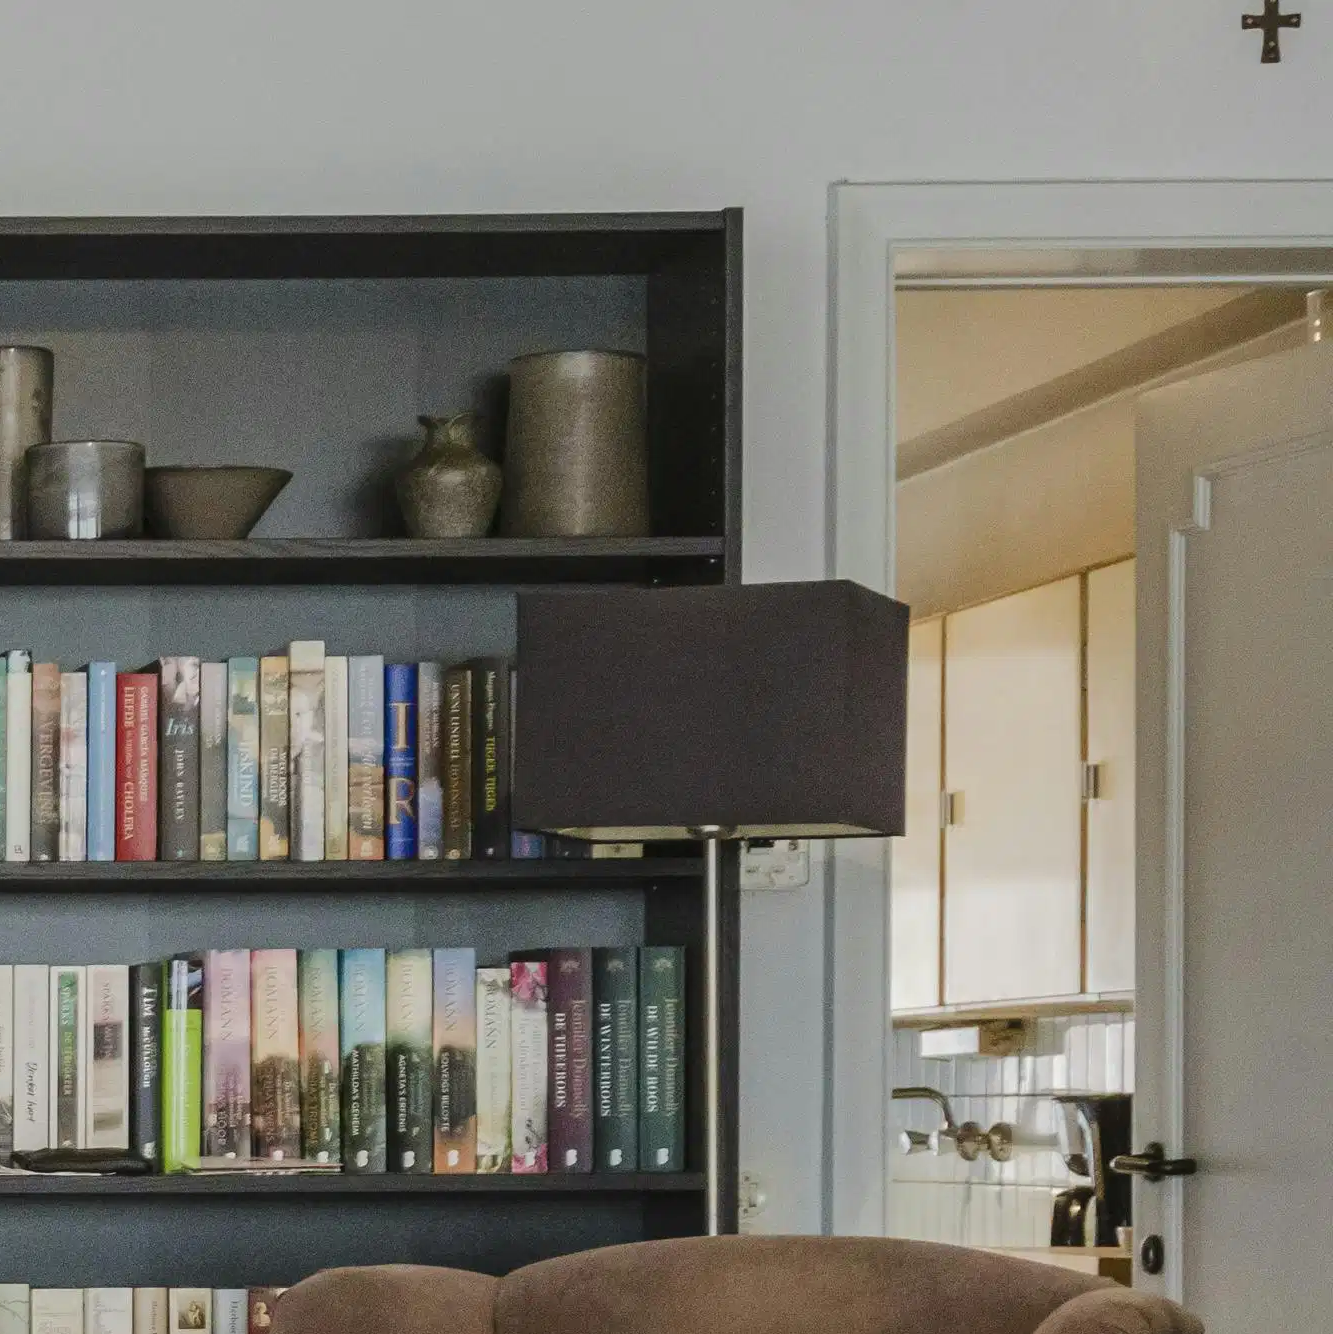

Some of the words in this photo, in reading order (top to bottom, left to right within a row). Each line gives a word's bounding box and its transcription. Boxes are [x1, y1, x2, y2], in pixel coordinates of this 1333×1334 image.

[124, 686, 135, 727] LIEFDE
[40, 720, 53, 823] VERGEVING
[124, 782, 135, 840] CHOLERA
[143, 986, 157, 1017] TIM
[555, 1013, 566, 1030] DE
[647, 1005, 657, 1022] DE
[647, 1027, 657, 1070] WILDE
[555, 1035, 566, 1108] THEEROOS
[647, 1075, 657, 1112] ROOS
